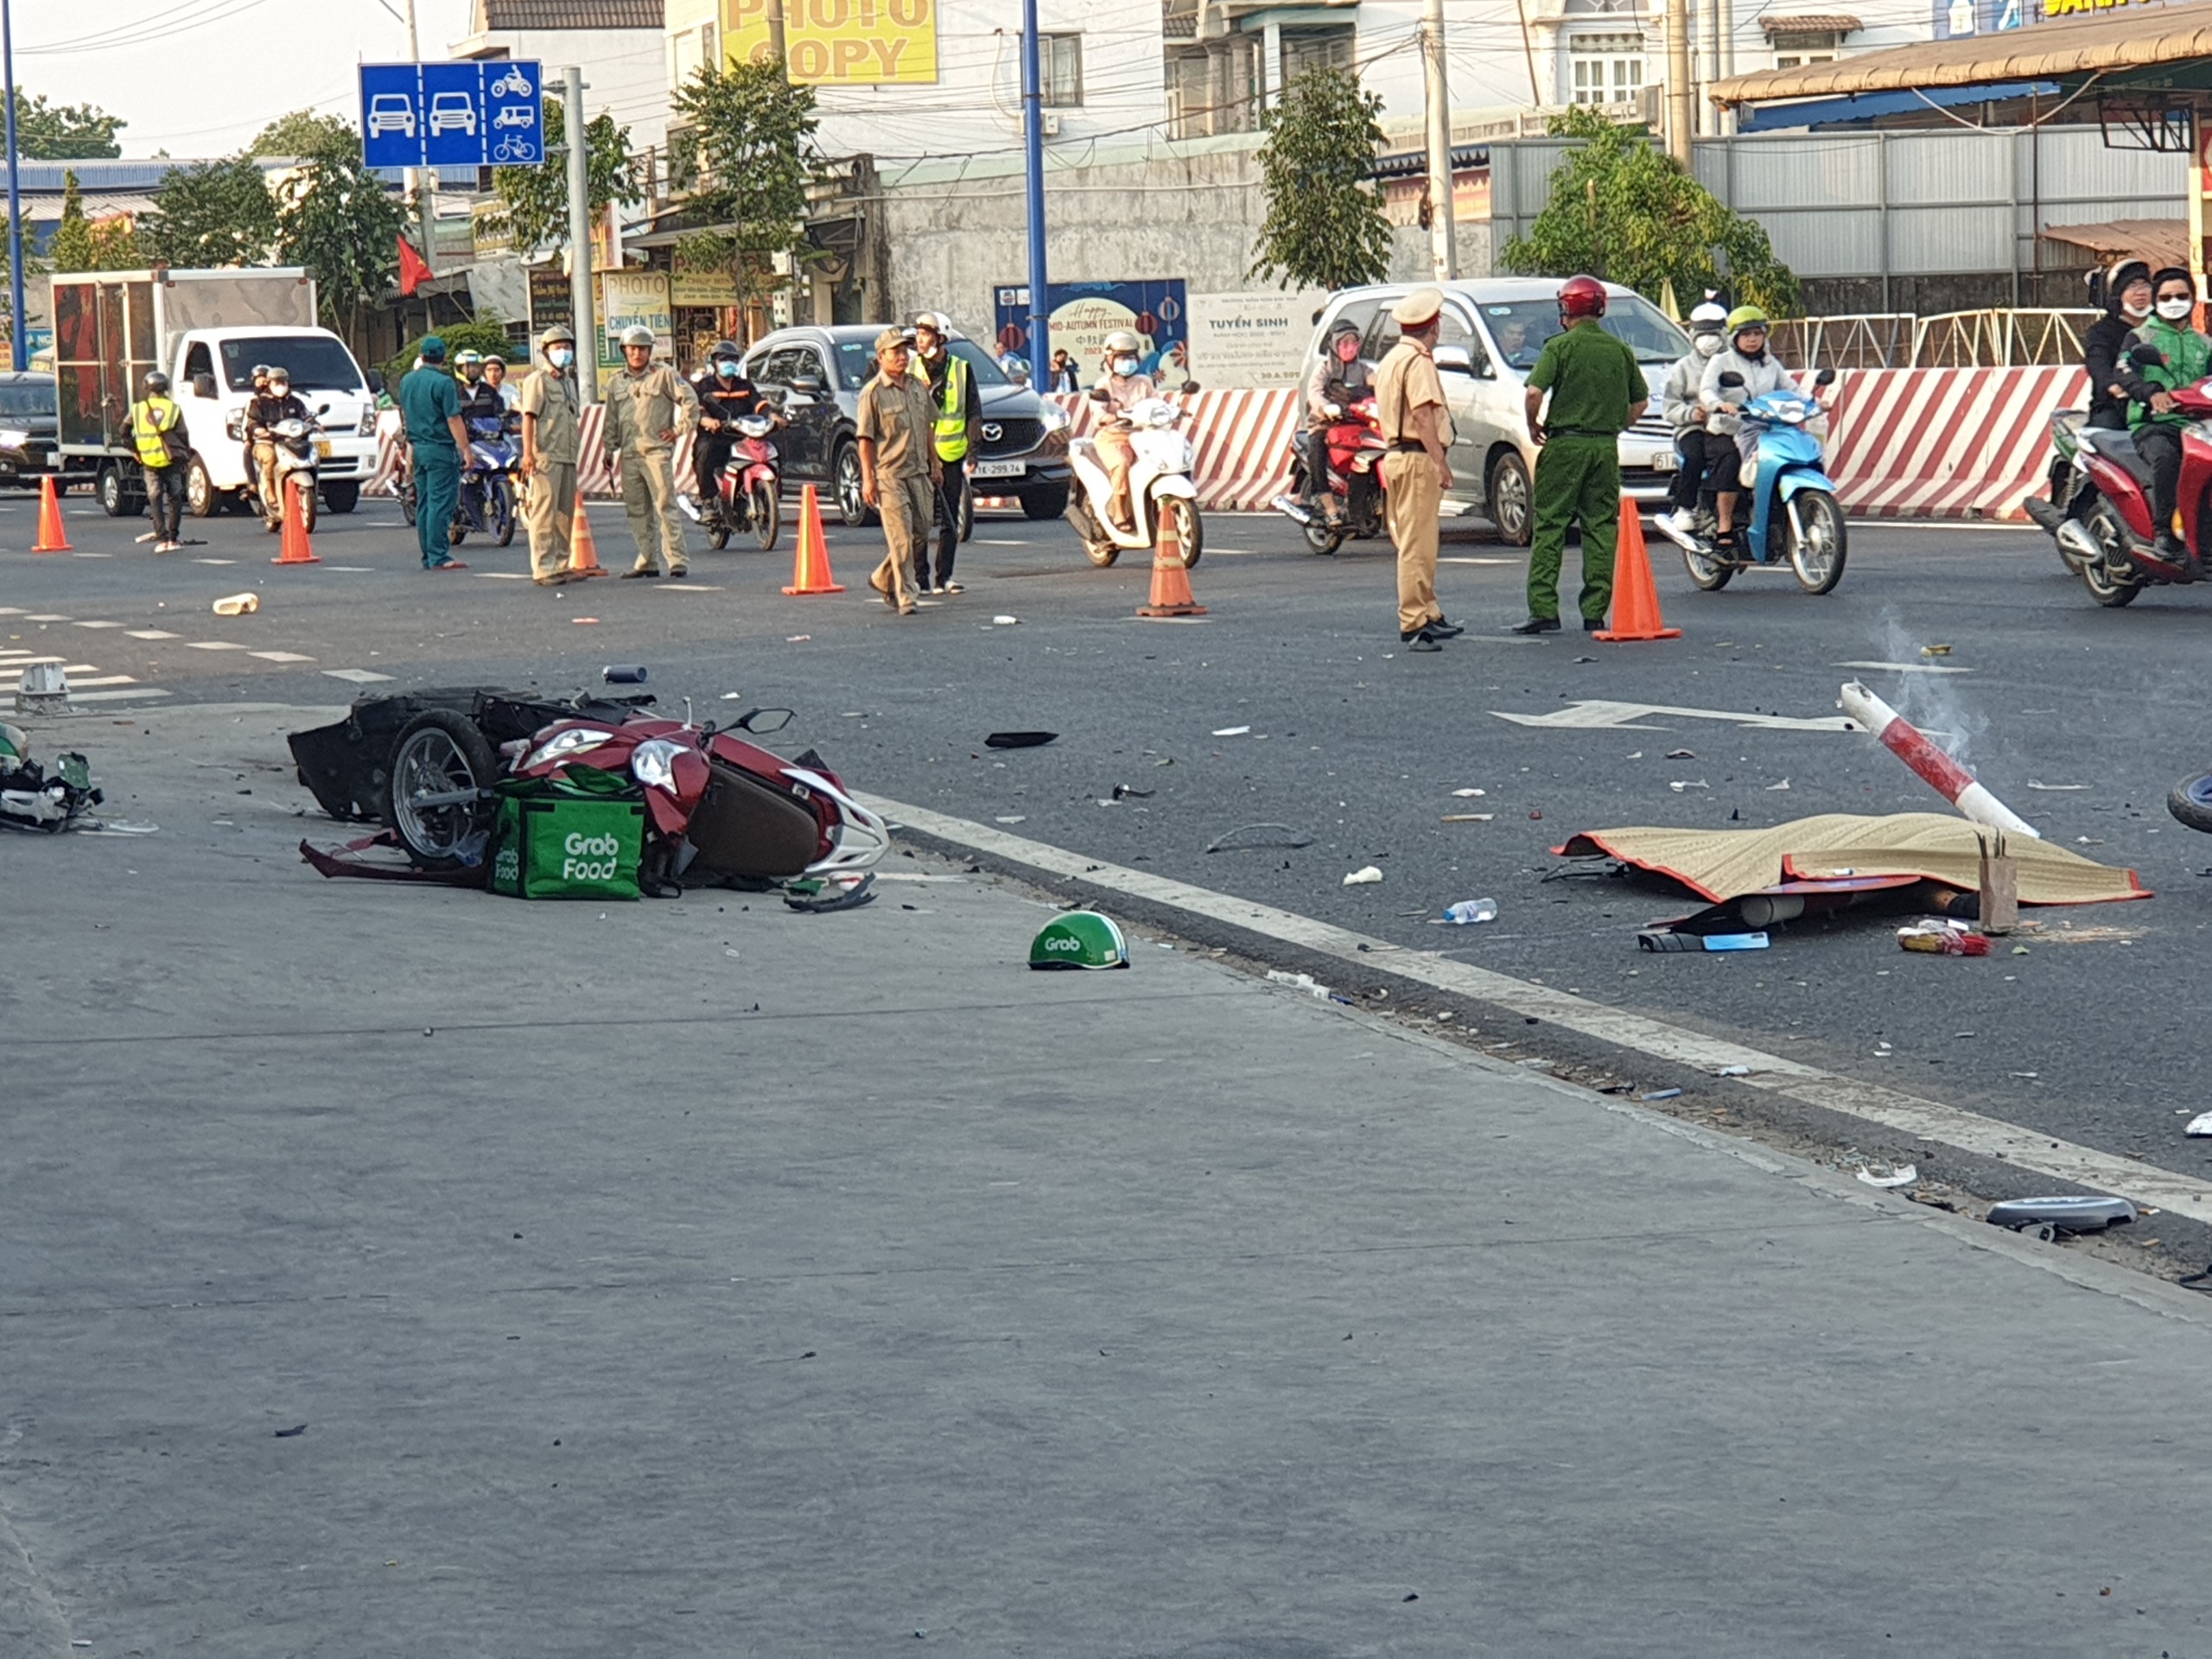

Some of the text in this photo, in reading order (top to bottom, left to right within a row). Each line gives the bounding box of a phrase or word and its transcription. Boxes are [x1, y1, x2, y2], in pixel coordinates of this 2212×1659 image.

[608, 276, 665, 295] PHOTO
[1069, 302, 1112, 321] Happy
[1099, 318, 1134, 329] FESTIVAL
[1209, 314, 1288, 329] TUYỂN SINH
[565, 832, 620, 856] Grab
[495, 848, 518, 863] Grab
[495, 864, 518, 880] Food
[563, 857, 618, 880] Food
[1045, 936, 1081, 951] Grab
